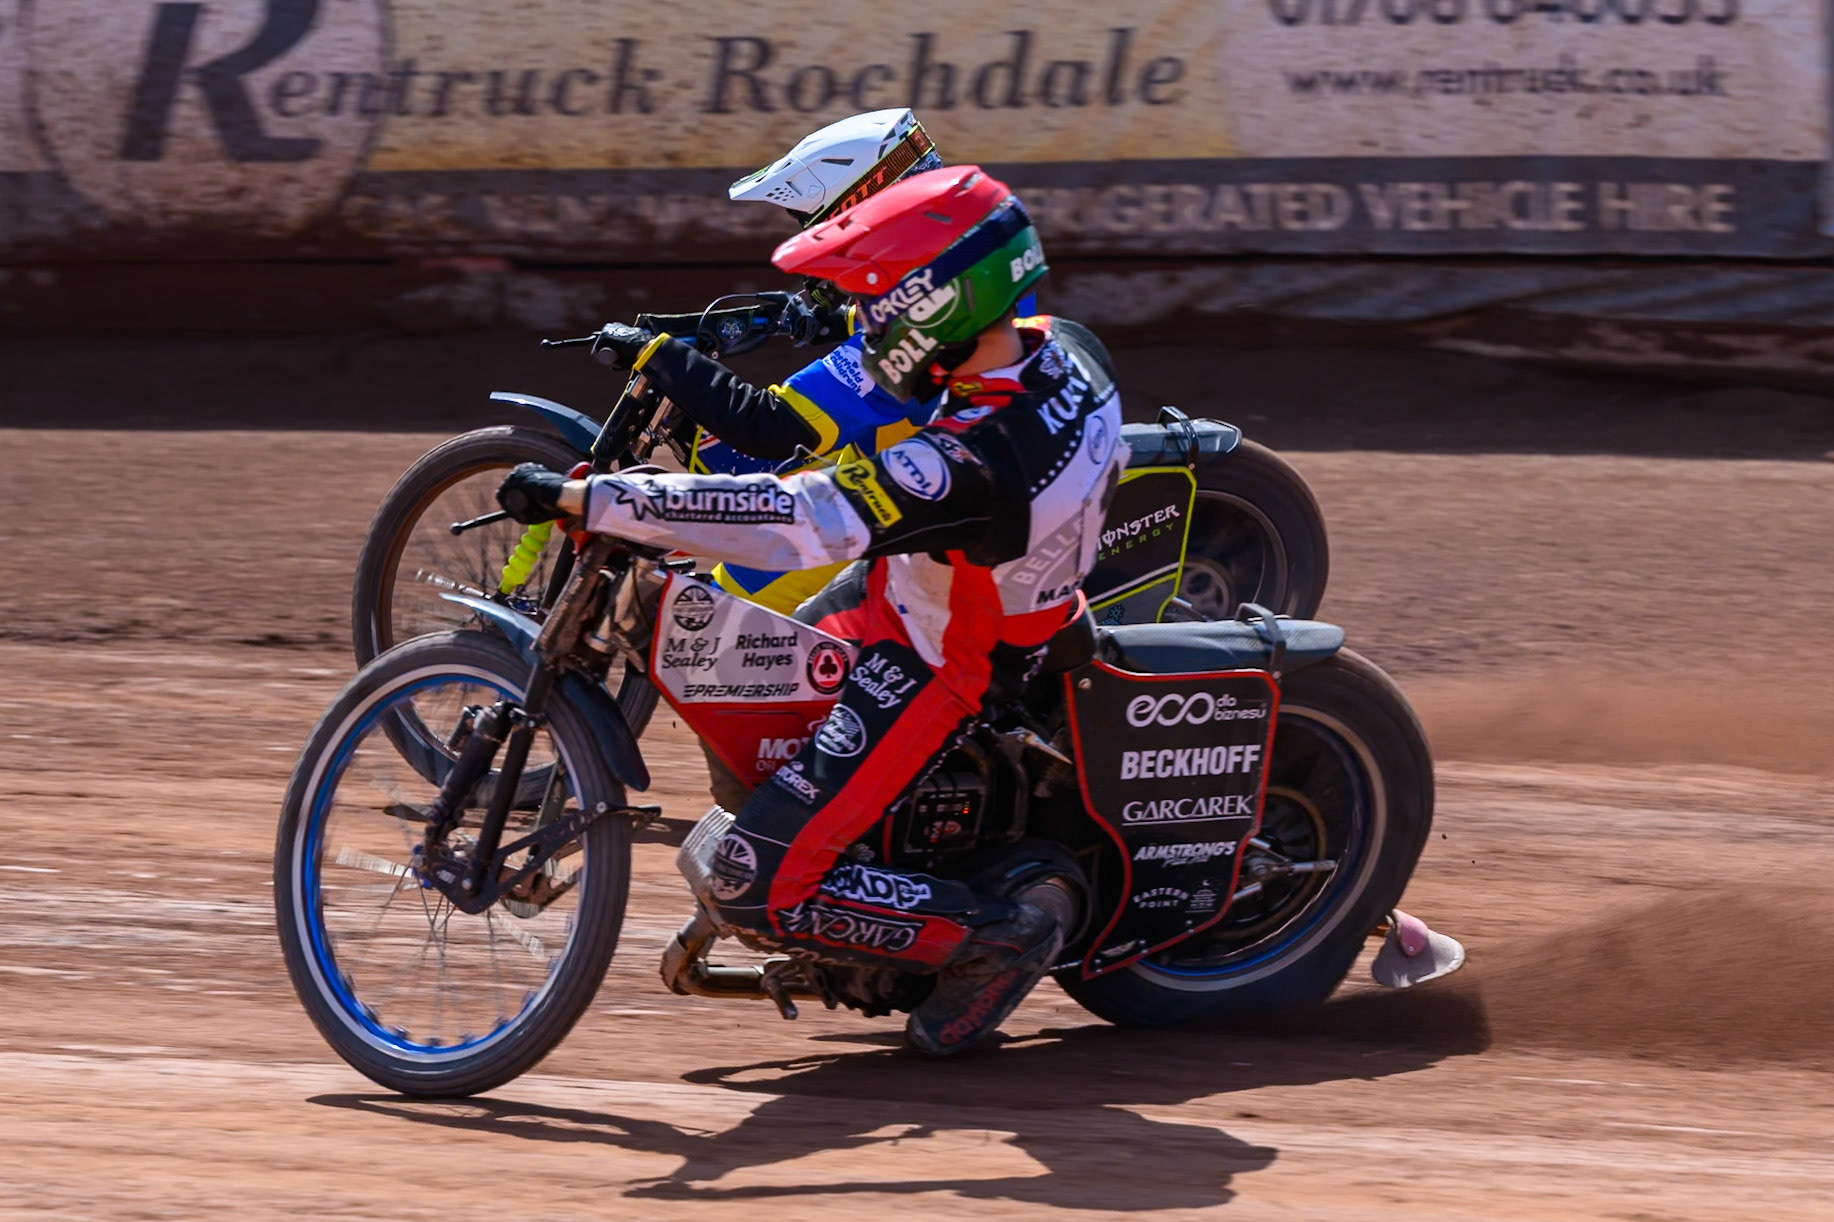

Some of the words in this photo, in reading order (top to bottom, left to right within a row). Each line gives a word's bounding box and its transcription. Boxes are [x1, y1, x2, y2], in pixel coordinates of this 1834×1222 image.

[703, 26, 1189, 114] Rochdale
[1358, 182, 1586, 232] VEHICLE
[1598, 183, 1738, 233] HIRE
[870, 268, 934, 323] OAKLEY
[878, 328, 939, 385] BOLL
[664, 483, 793, 515] burnside
[1098, 522, 1175, 561] ENERGY
[664, 637, 687, 652] M
[690, 637, 708, 652] &
[709, 636, 723, 655] J
[735, 631, 798, 650] Richard
[661, 653, 718, 672] Sealey
[741, 651, 793, 670] Hayes
[864, 652, 885, 673] M
[882, 665, 904, 683] &
[848, 666, 903, 709] Sealey
[1126, 691, 1215, 728] eco
[1120, 744, 1262, 780] BECKHOFF
[1122, 795, 1254, 823] GARCAREK
[1133, 841, 1238, 862] ARMSTRONG'S
[1132, 887, 1190, 904] EASTERN
[1139, 898, 1180, 910] POINT
[778, 902, 916, 952] GARCAK
